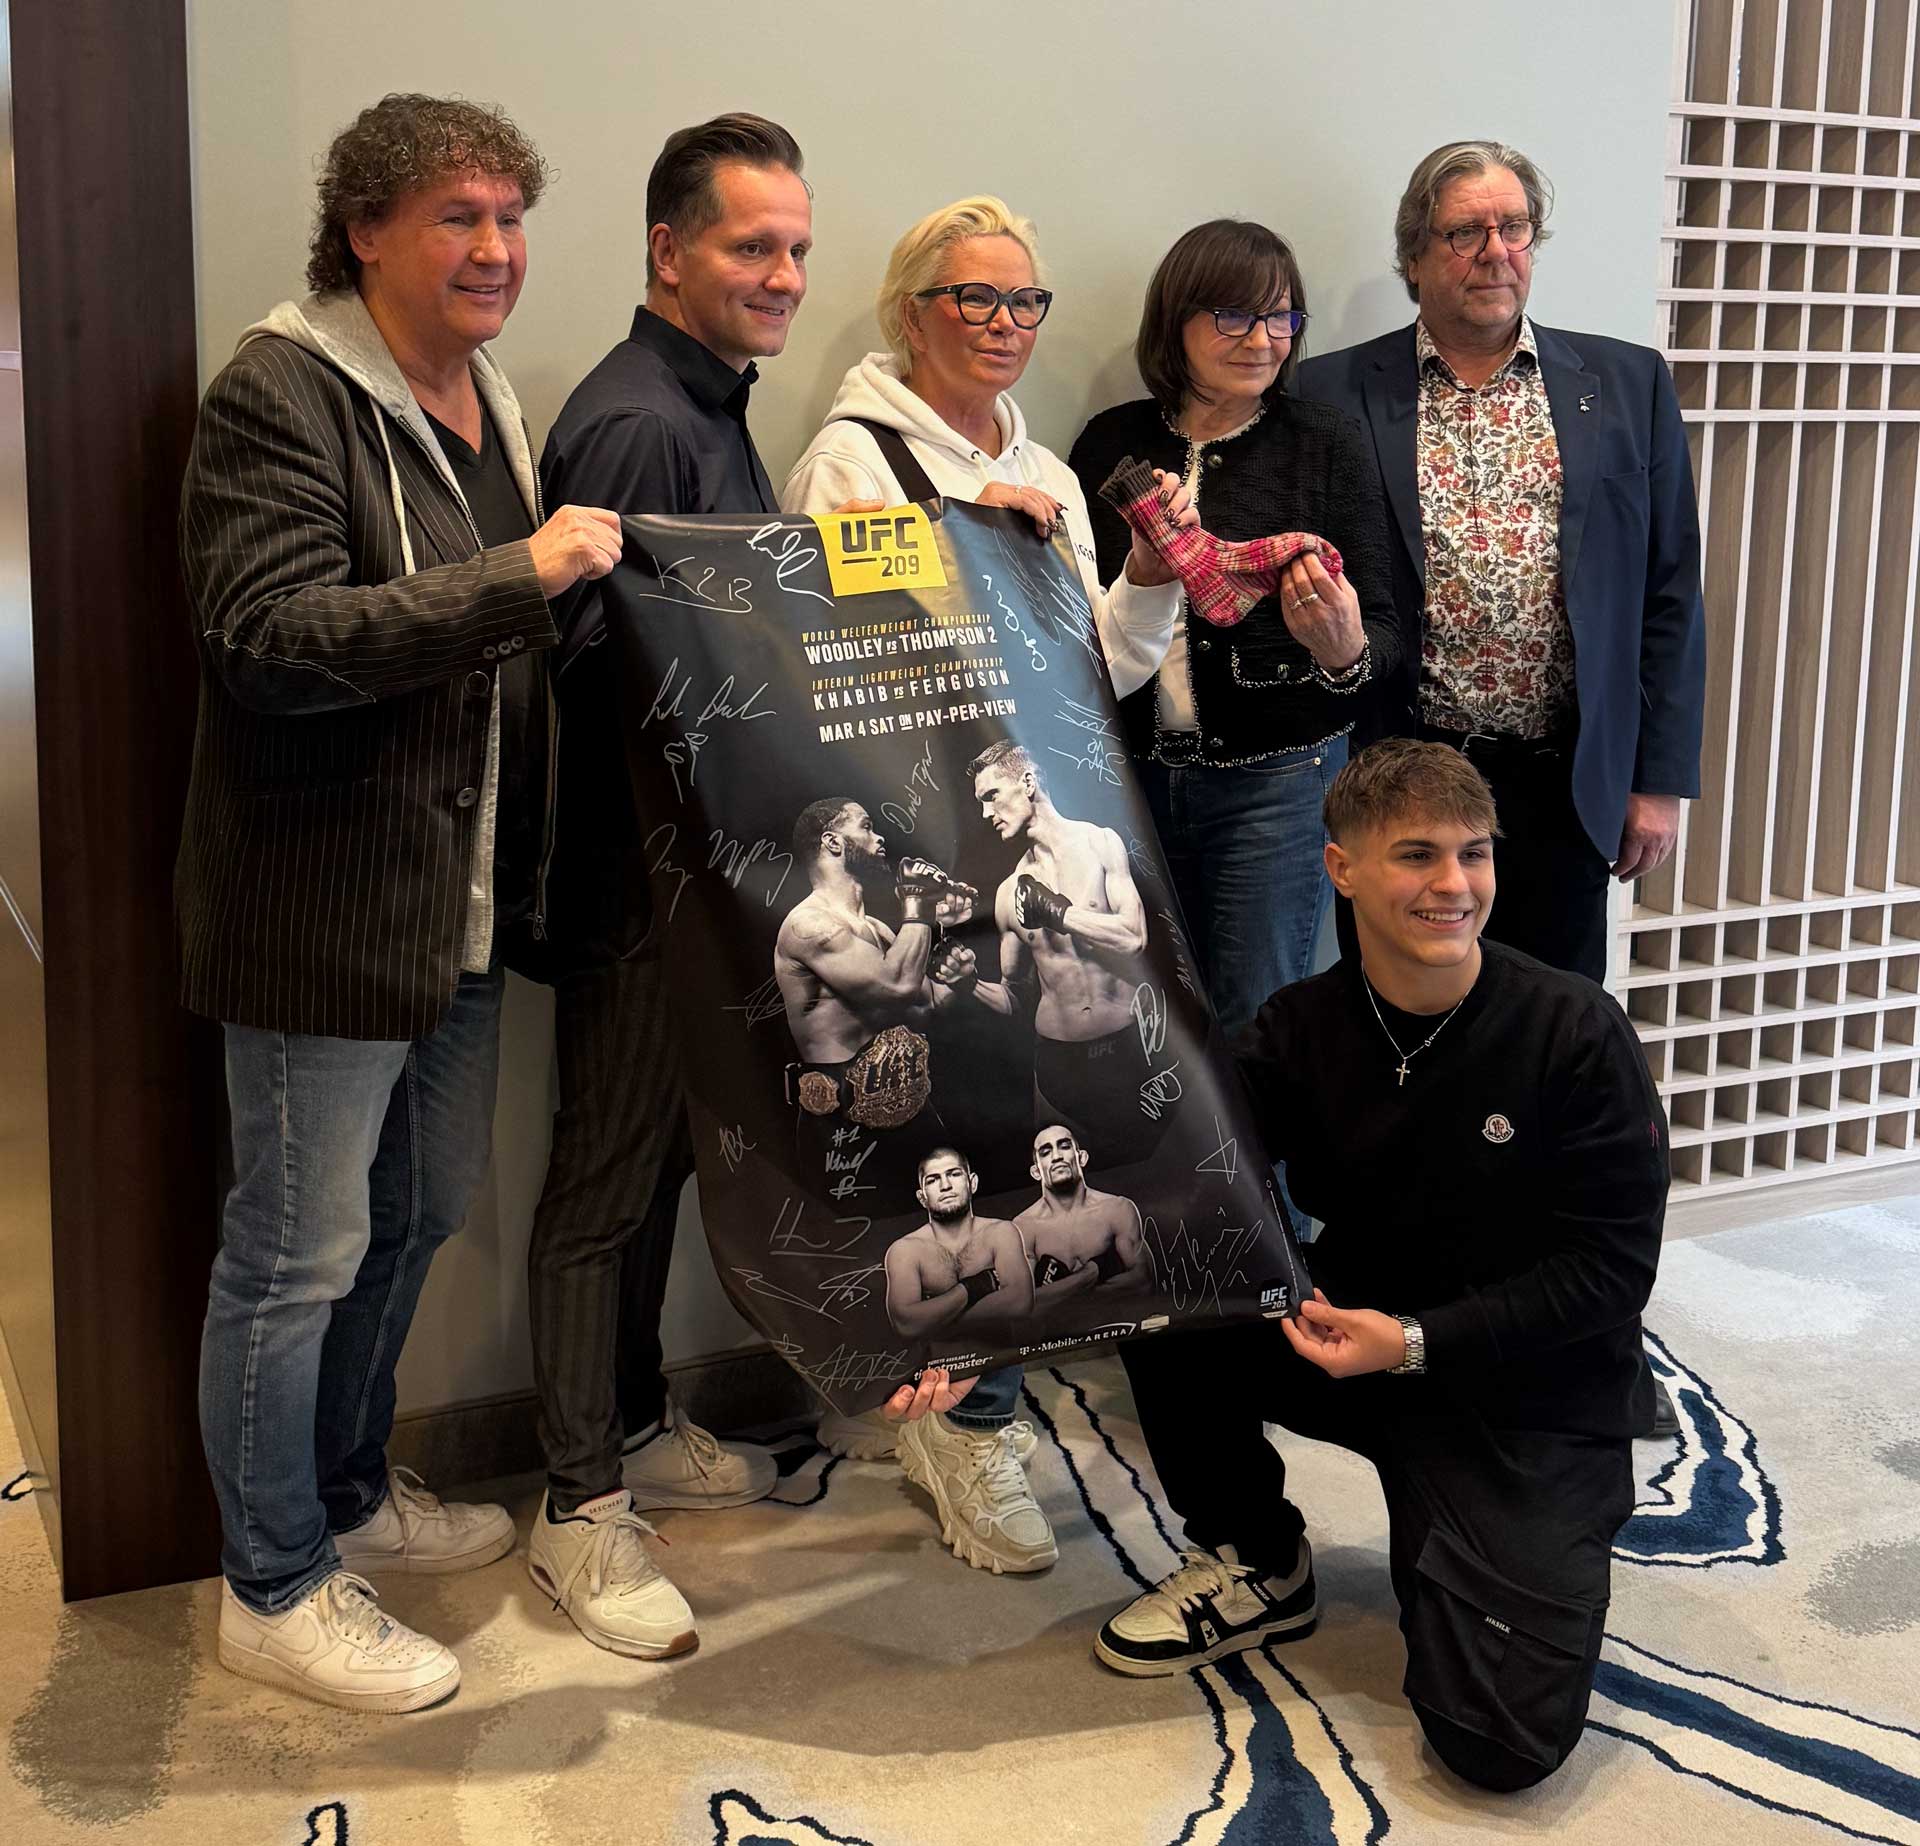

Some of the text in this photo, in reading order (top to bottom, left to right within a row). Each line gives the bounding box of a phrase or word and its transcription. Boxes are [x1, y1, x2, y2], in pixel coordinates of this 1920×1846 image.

[841, 517, 918, 553] UFC
[881, 555, 919, 577] 209
[802, 614, 991, 643] WORLD WELTERWEIGHT CHAMPIONSHIP
[804, 638, 883, 664] WOODLEY
[899, 628, 986, 652] THOMPSON
[988, 626, 998, 644] 2
[812, 657, 1004, 691] INTERIM LIGHTWEIGHT CHAMPIONSHIP
[814, 685, 888, 711] KHABIB
[910, 669, 1010, 697] FERGUSON
[819, 699, 1017, 744] MAR 4 SAT ON PAY-PER-VIEW
[911, 862, 945, 882] UFC
[1261, 1287, 1288, 1303] UFC
[1085, 1328, 1127, 1342] ARENA
